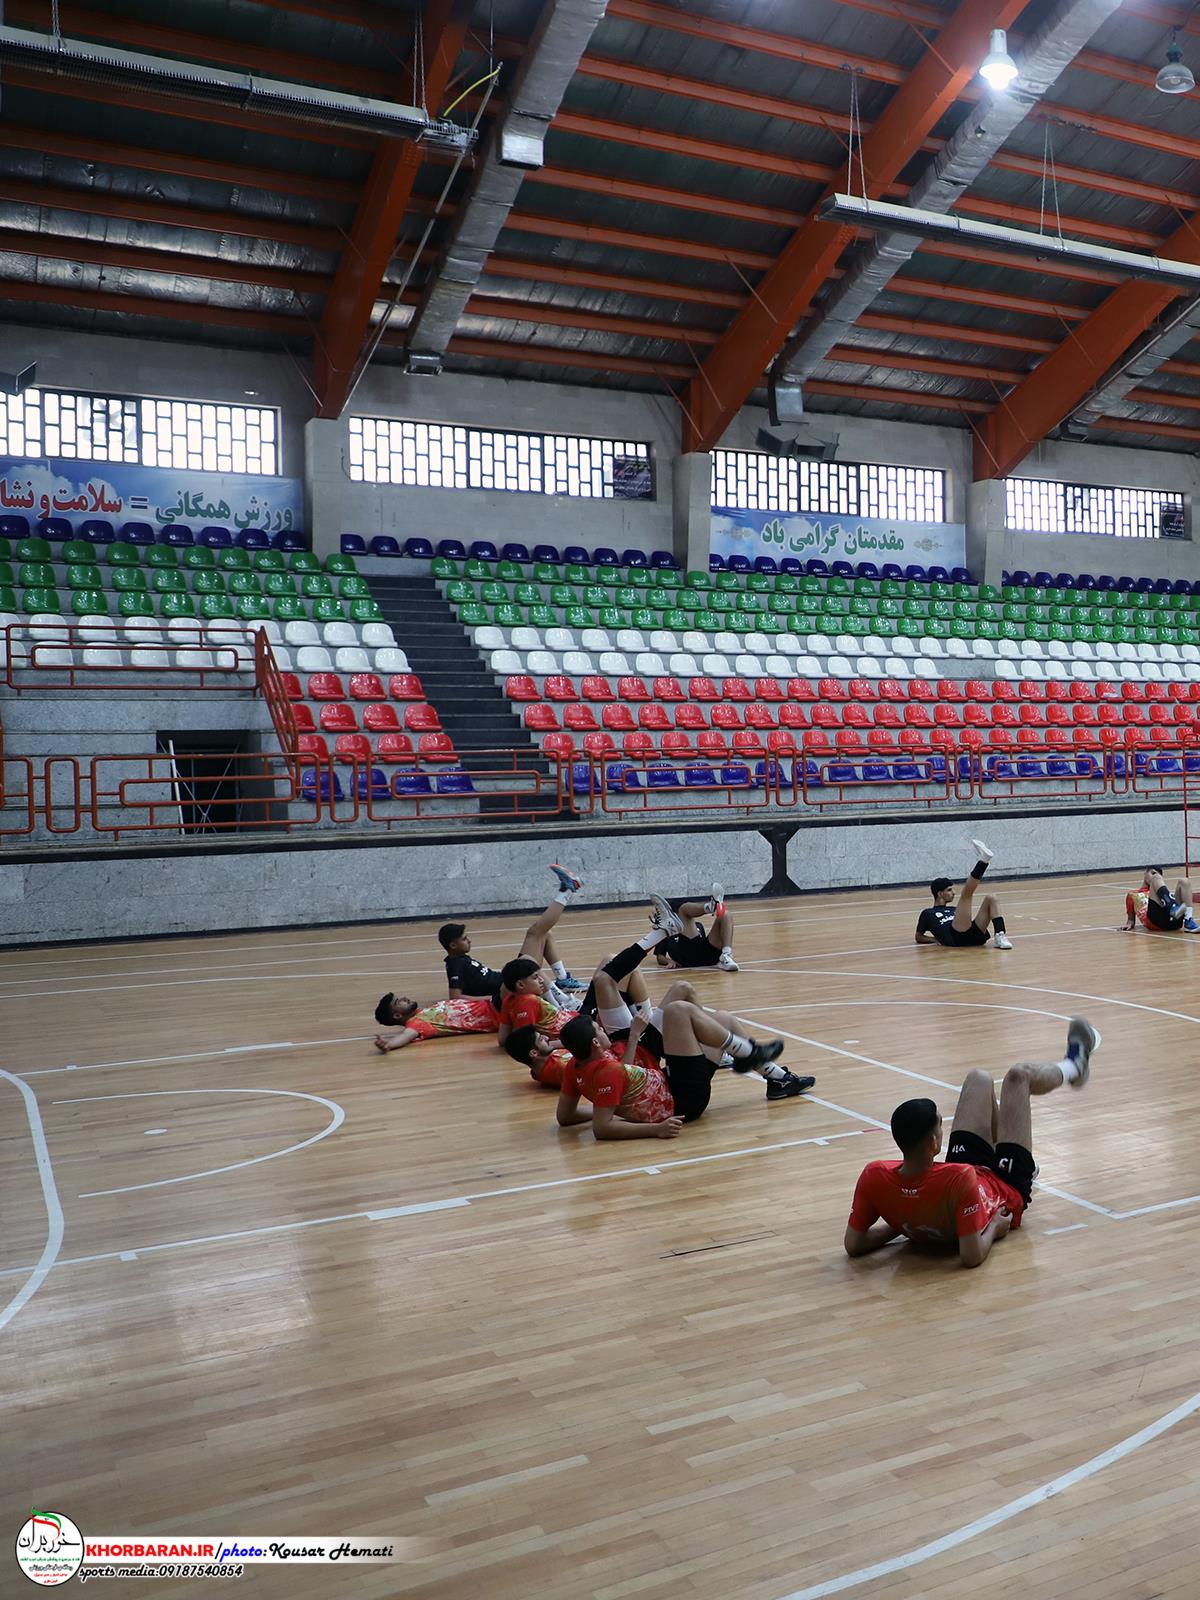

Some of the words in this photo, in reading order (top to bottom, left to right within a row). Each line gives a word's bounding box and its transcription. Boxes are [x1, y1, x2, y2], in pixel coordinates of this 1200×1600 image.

[0, 480, 34, 509] نشا
[52, 483, 122, 513] سلامت
[155, 489, 231, 524] همگانی
[234, 495, 293, 531] ورزش
[762, 519, 785, 549] باد
[789, 523, 840, 553] گرامی
[844, 526, 905, 555] مقدمتان
